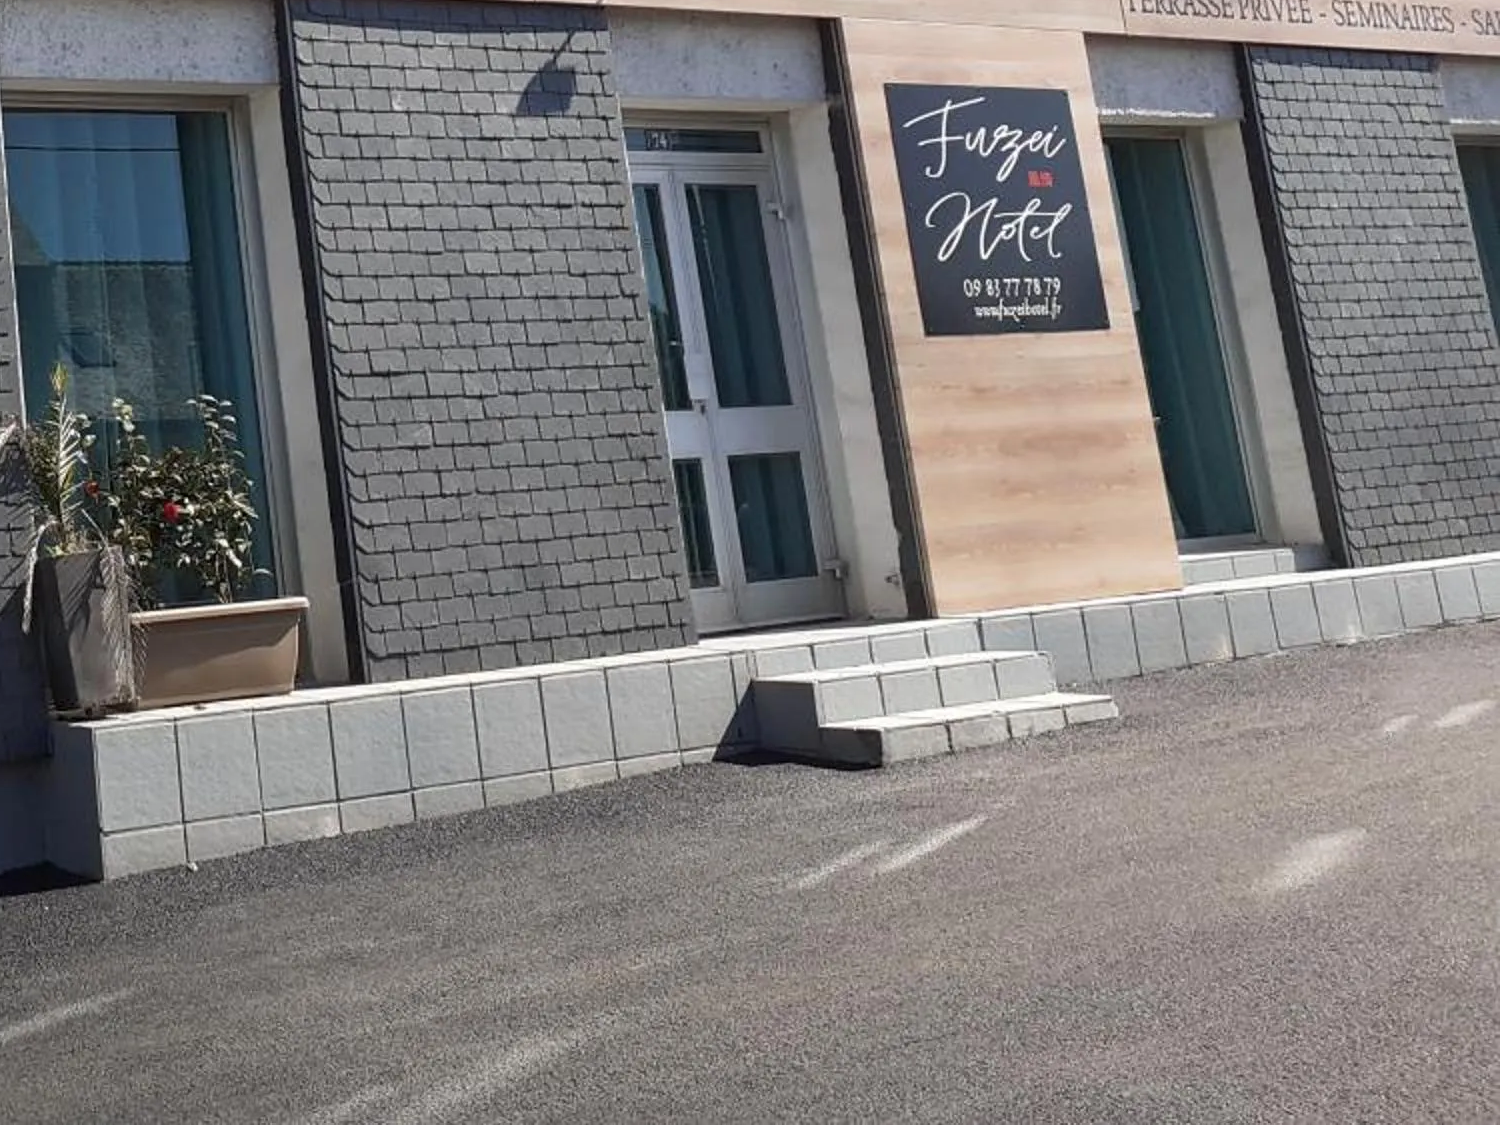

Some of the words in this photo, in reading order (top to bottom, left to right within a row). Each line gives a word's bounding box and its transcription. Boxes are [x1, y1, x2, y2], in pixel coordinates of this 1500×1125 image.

[902, 96, 1067, 182] Fuzei
[925, 191, 1073, 262] Hotel
[963, 278, 981, 297] 09
[1003, 277, 1020, 296] 77
[1023, 277, 1041, 296] 78
[1043, 276, 1061, 296] 79
